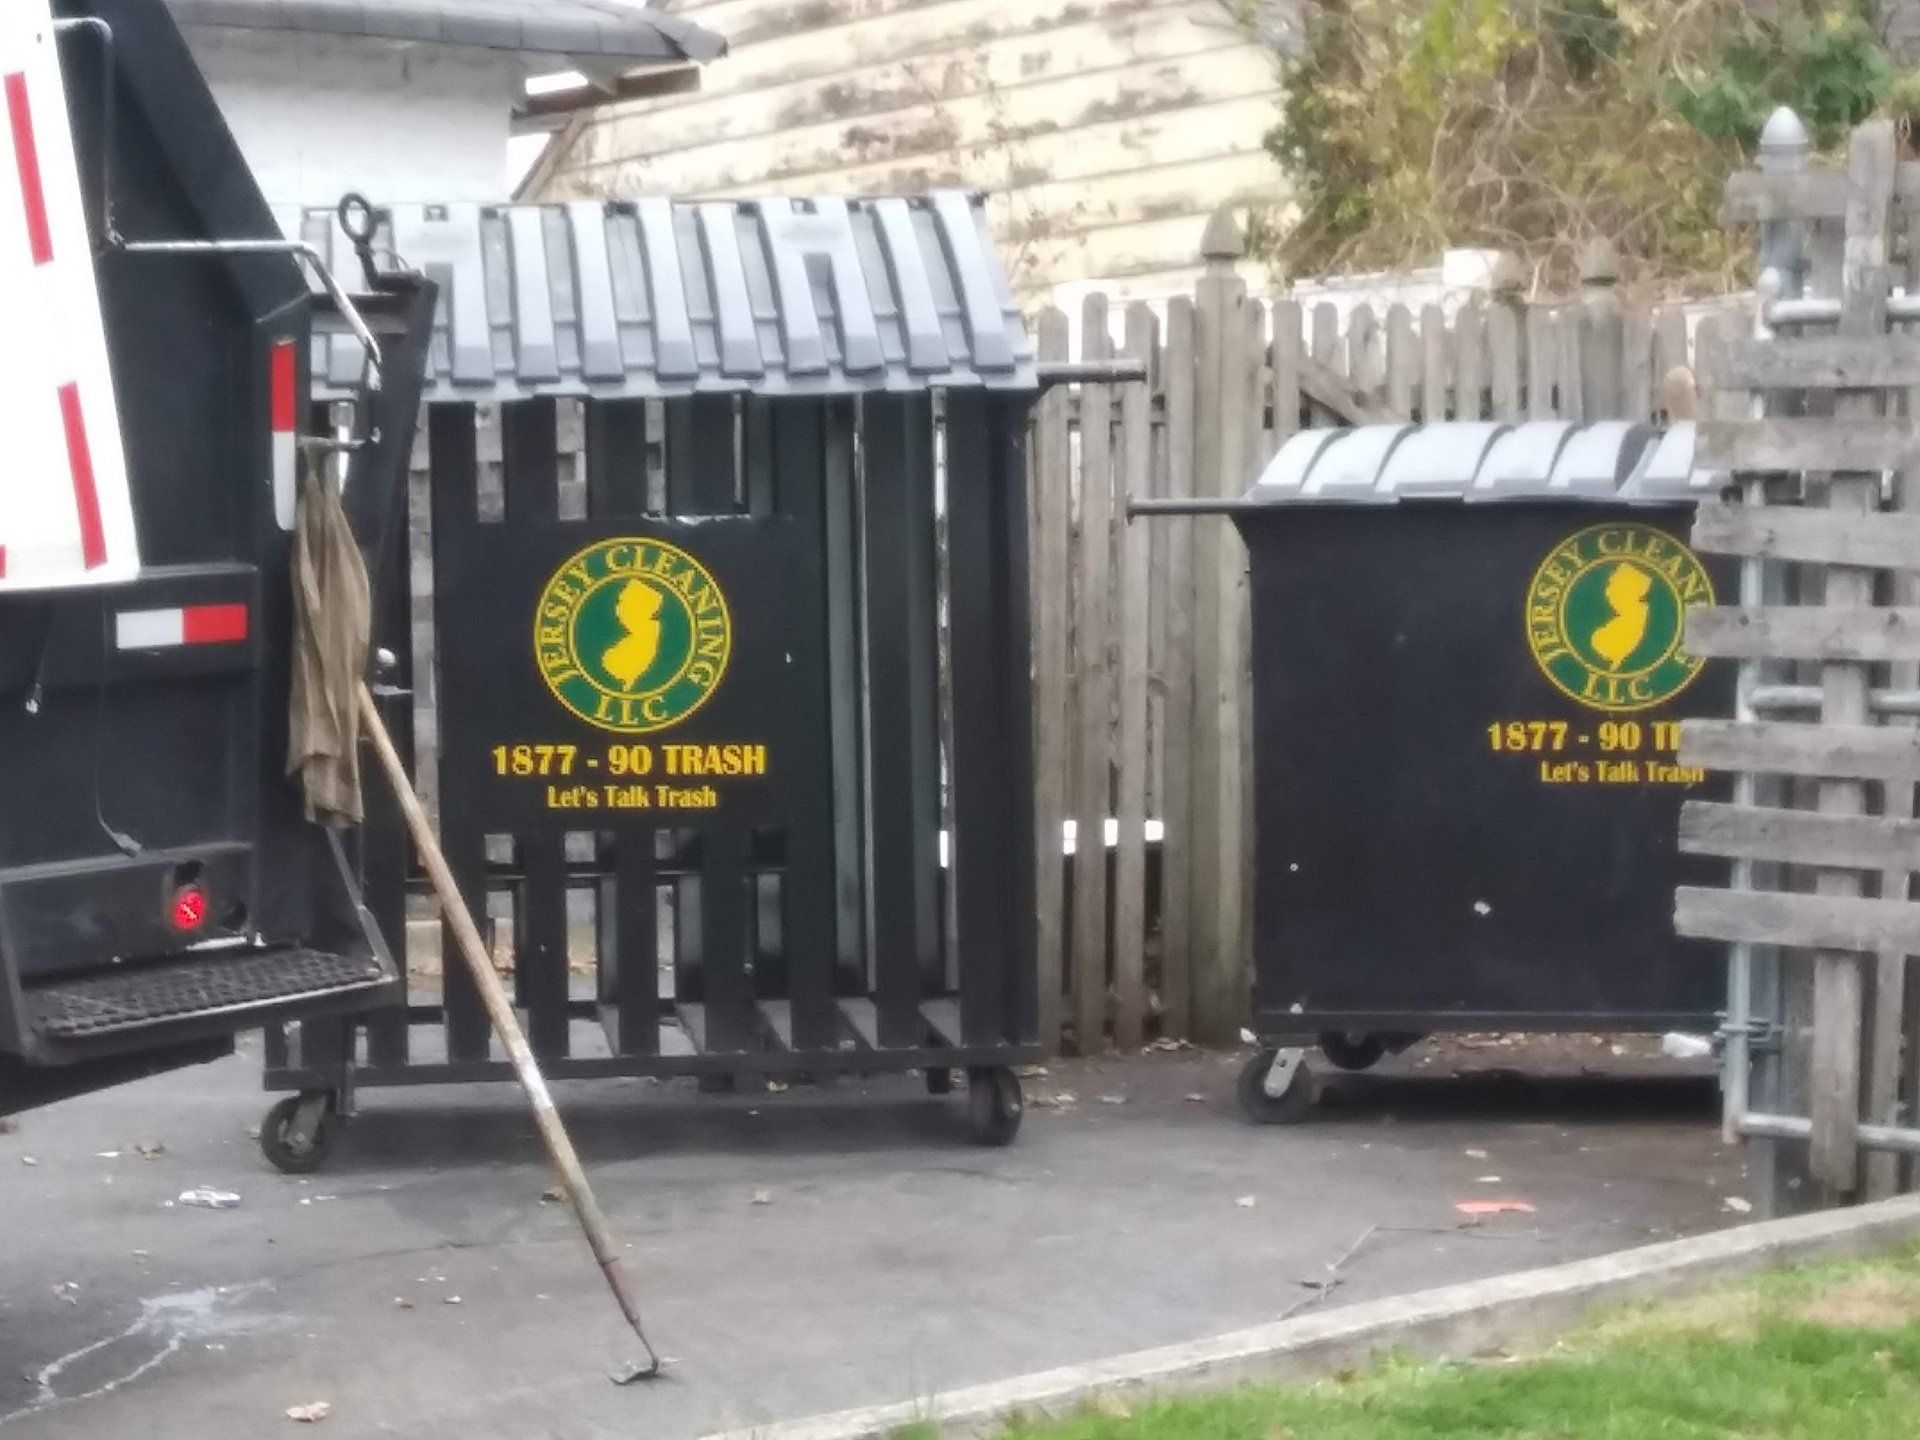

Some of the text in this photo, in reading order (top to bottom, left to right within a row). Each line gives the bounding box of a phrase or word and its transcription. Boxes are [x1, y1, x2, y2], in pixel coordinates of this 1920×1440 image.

[541, 545, 725, 687] JERSEY CLEANING
[1533, 541, 1583, 663] JERSEY
[1584, 676, 1653, 704] LLC
[596, 694, 668, 725] LLC
[1487, 721, 1569, 751] 1877
[1578, 734, 1590, 744] -
[1598, 721, 1642, 751] 90
[493, 744, 767, 776] 1877 - 90 TRASH
[1540, 760, 1590, 783] Let's
[1595, 760, 1639, 783] Talk
[547, 785, 717, 808] Let's Talk Trash
